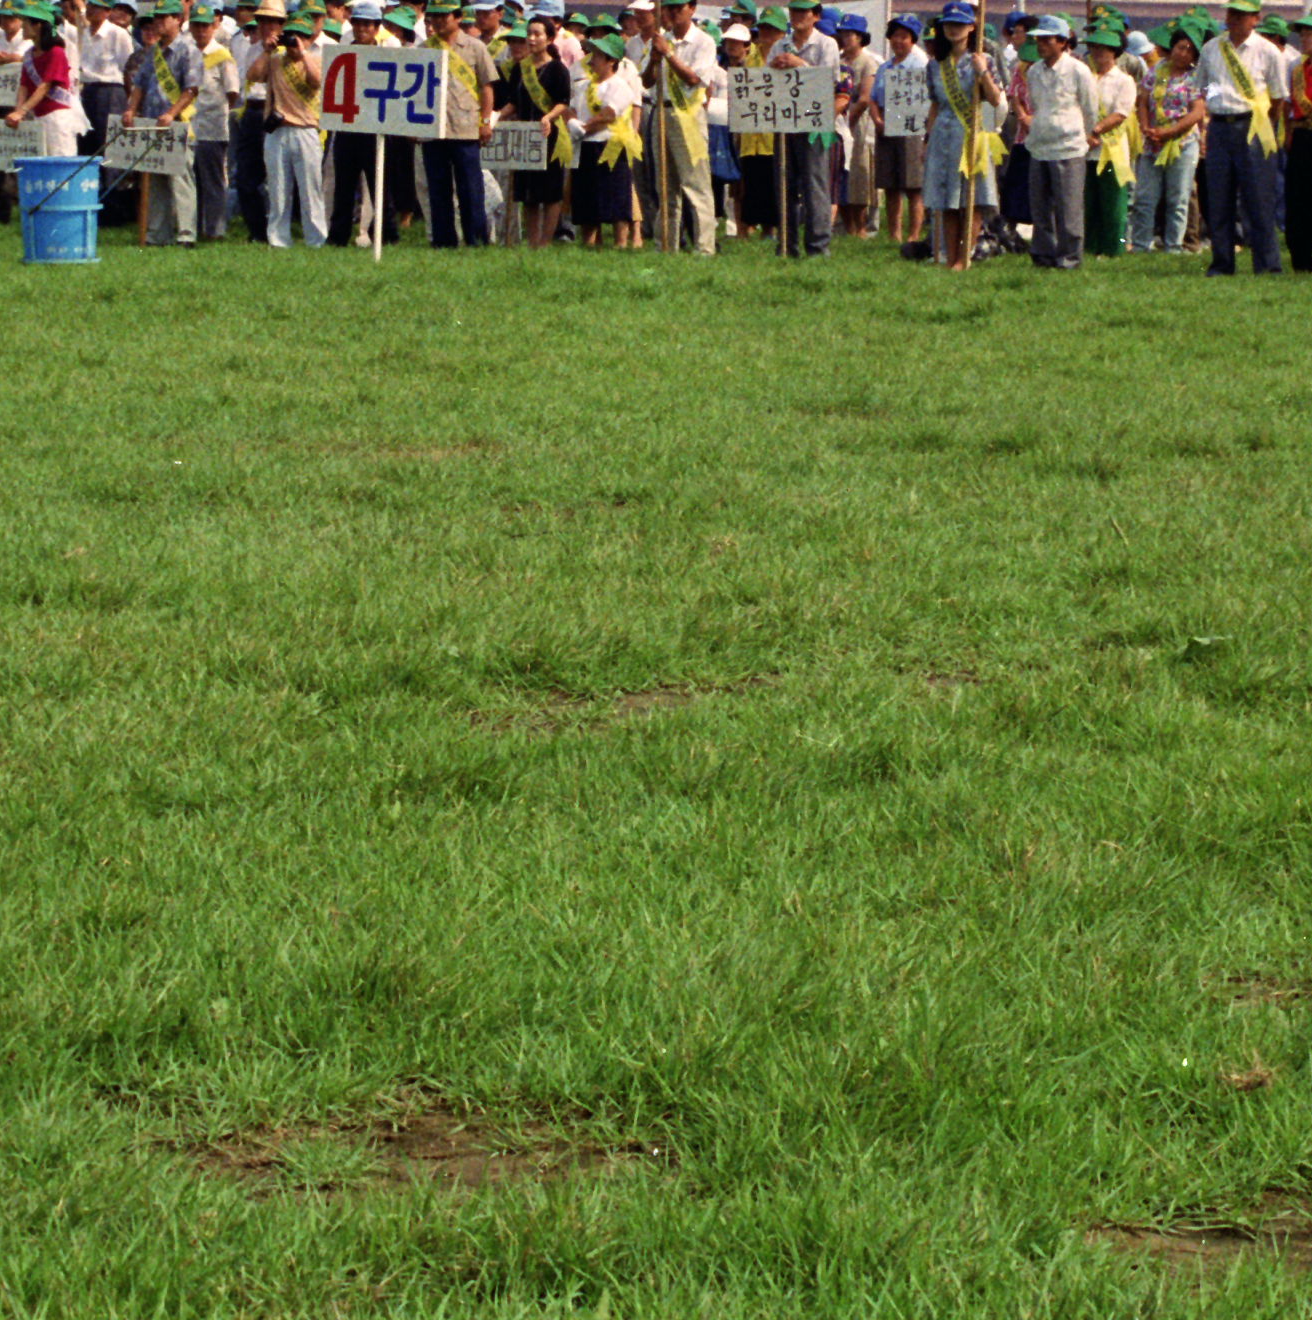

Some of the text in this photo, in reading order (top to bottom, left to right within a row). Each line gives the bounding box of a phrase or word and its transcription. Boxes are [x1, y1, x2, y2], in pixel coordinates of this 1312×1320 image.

[322, 52, 442, 125] 4구간
[785, 70, 804, 98] 강
[740, 100, 823, 127] 우리마음
